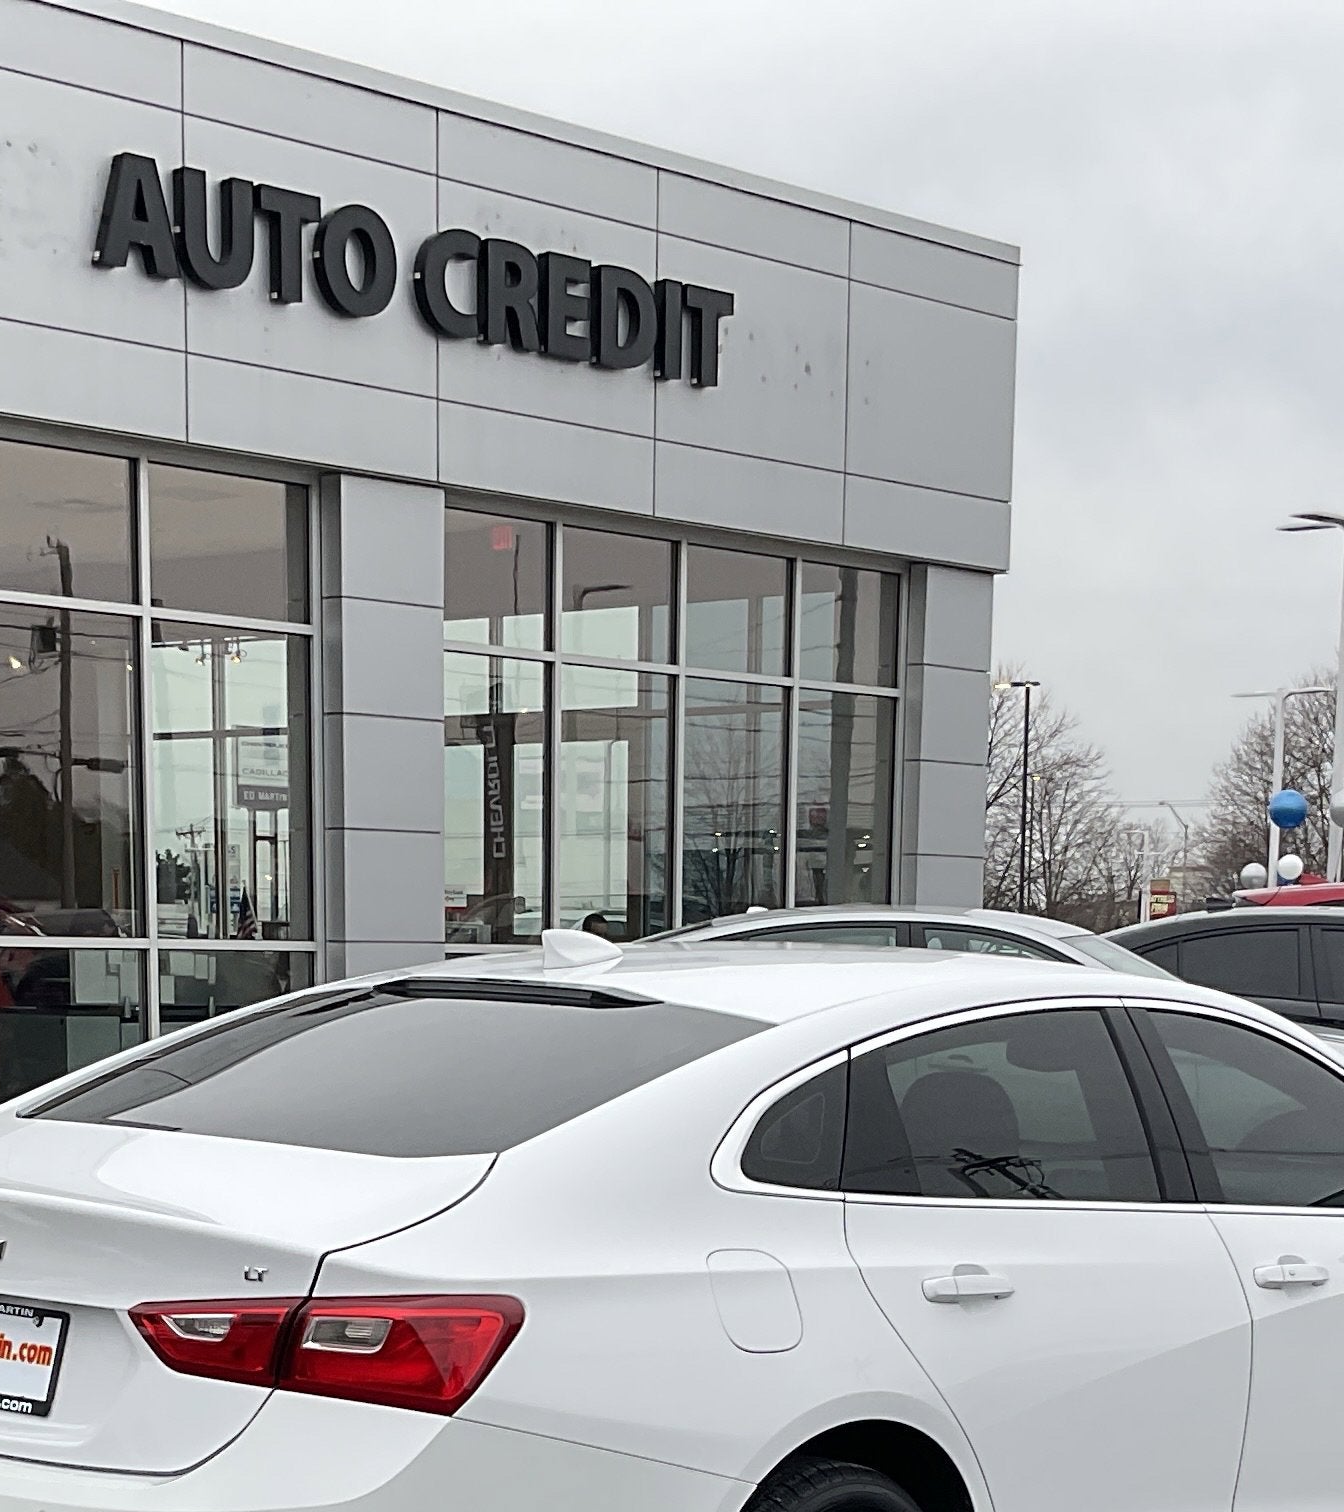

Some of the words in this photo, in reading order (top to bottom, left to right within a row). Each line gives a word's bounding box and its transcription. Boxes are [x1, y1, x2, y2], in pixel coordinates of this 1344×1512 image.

[92, 152, 397, 318] AUTO
[413, 229, 734, 387] CREDIT
[243, 790, 255, 801] ED
[243, 1265, 269, 1282] LT
